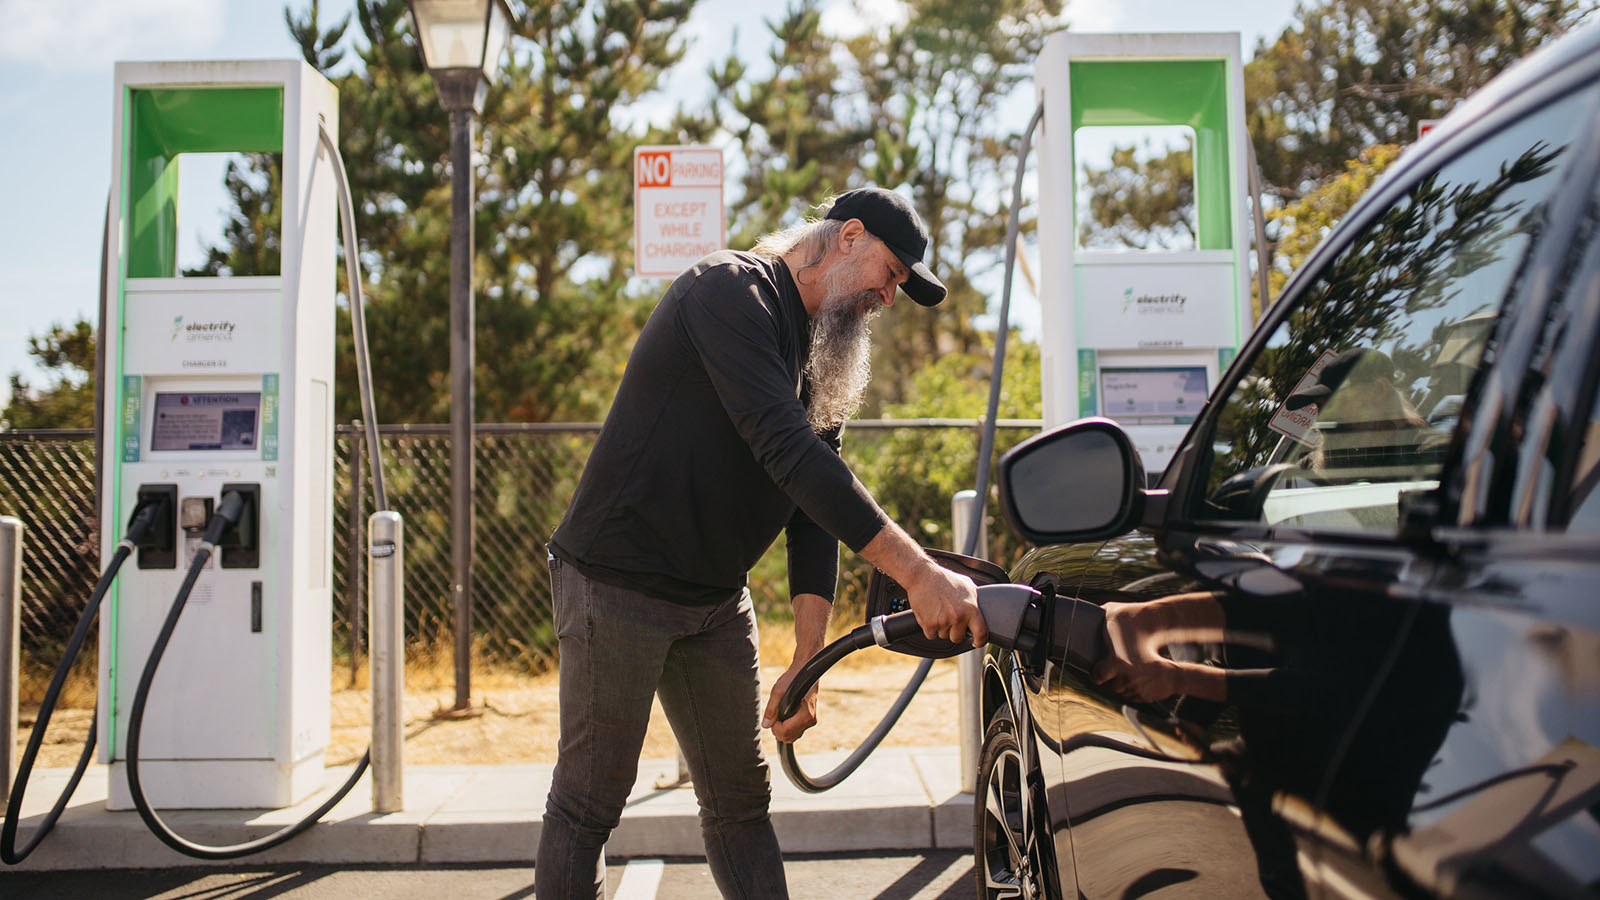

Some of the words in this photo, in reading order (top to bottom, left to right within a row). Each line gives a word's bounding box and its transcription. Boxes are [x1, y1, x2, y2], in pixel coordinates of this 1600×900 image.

[640, 155, 670, 184] NO
[673, 162, 719, 178] PARKING
[654, 202, 707, 217] EXCEPT
[659, 222, 702, 238] WHILE
[1137, 294, 1187, 305] electrify
[185, 320, 236, 333] electrify
